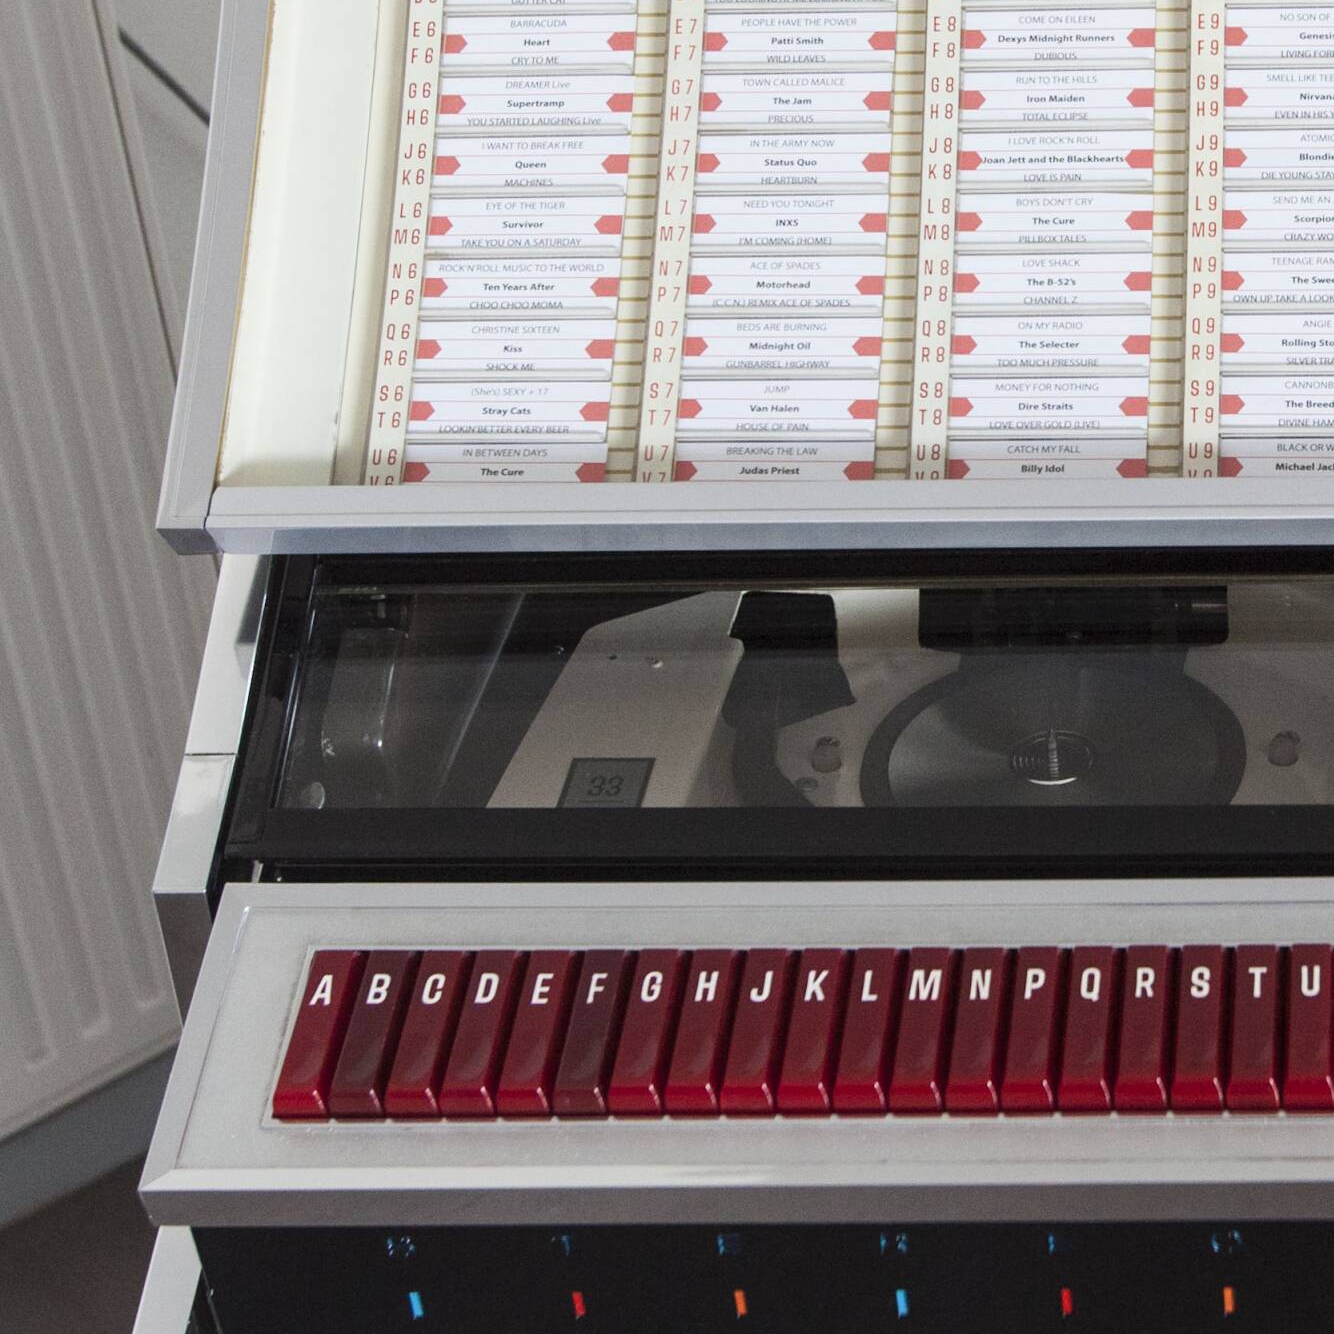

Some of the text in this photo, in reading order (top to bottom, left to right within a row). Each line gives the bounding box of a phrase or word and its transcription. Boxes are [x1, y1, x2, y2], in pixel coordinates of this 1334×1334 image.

[523, 38, 550, 46] Heart
[770, 36, 824, 45] Patti Smith
[772, 97, 813, 105] The Jam
[514, 160, 547, 170] Queen
[764, 158, 818, 167] Status Quo
[775, 219, 799, 227] INXS
[749, 404, 800, 413] Van Halen
[1018, 402, 1074, 411] Dire Straits
[481, 406, 532, 417] Stray Cats
[726, 446, 819, 456] BREAKING THE LAW
[1276, 443, 1309, 452] BLACK
[1309, 443, 1325, 452] OR
[739, 466, 800, 475] Judas Priest
[1020, 464, 1065, 475] Billy Idol
[1275, 462, 1316, 471] Michael
[480, 467, 525, 476] The Cure
[586, 774, 625, 798] 33
[308, 974, 334, 1006] A
[366, 973, 392, 1005] B
[421, 973, 446, 1005] C
[474, 972, 500, 1004] D
[531, 973, 554, 1005] E
[586, 972, 608, 1004] F
[640, 971, 663, 1003] G
[694, 970, 720, 1002] H
[749, 970, 774, 1003] J
[804, 970, 829, 1002] K
[861, 969, 878, 1002] L
[908, 969, 942, 1001] M
[969, 969, 992, 1001] N
[1024, 968, 1046, 1000] P
[1080, 967, 1101, 1002] Q
[1135, 967, 1155, 998] R
[1190, 966, 1211, 998] S
[1248, 966, 1268, 998] T
[1301, 964, 1321, 997] U
